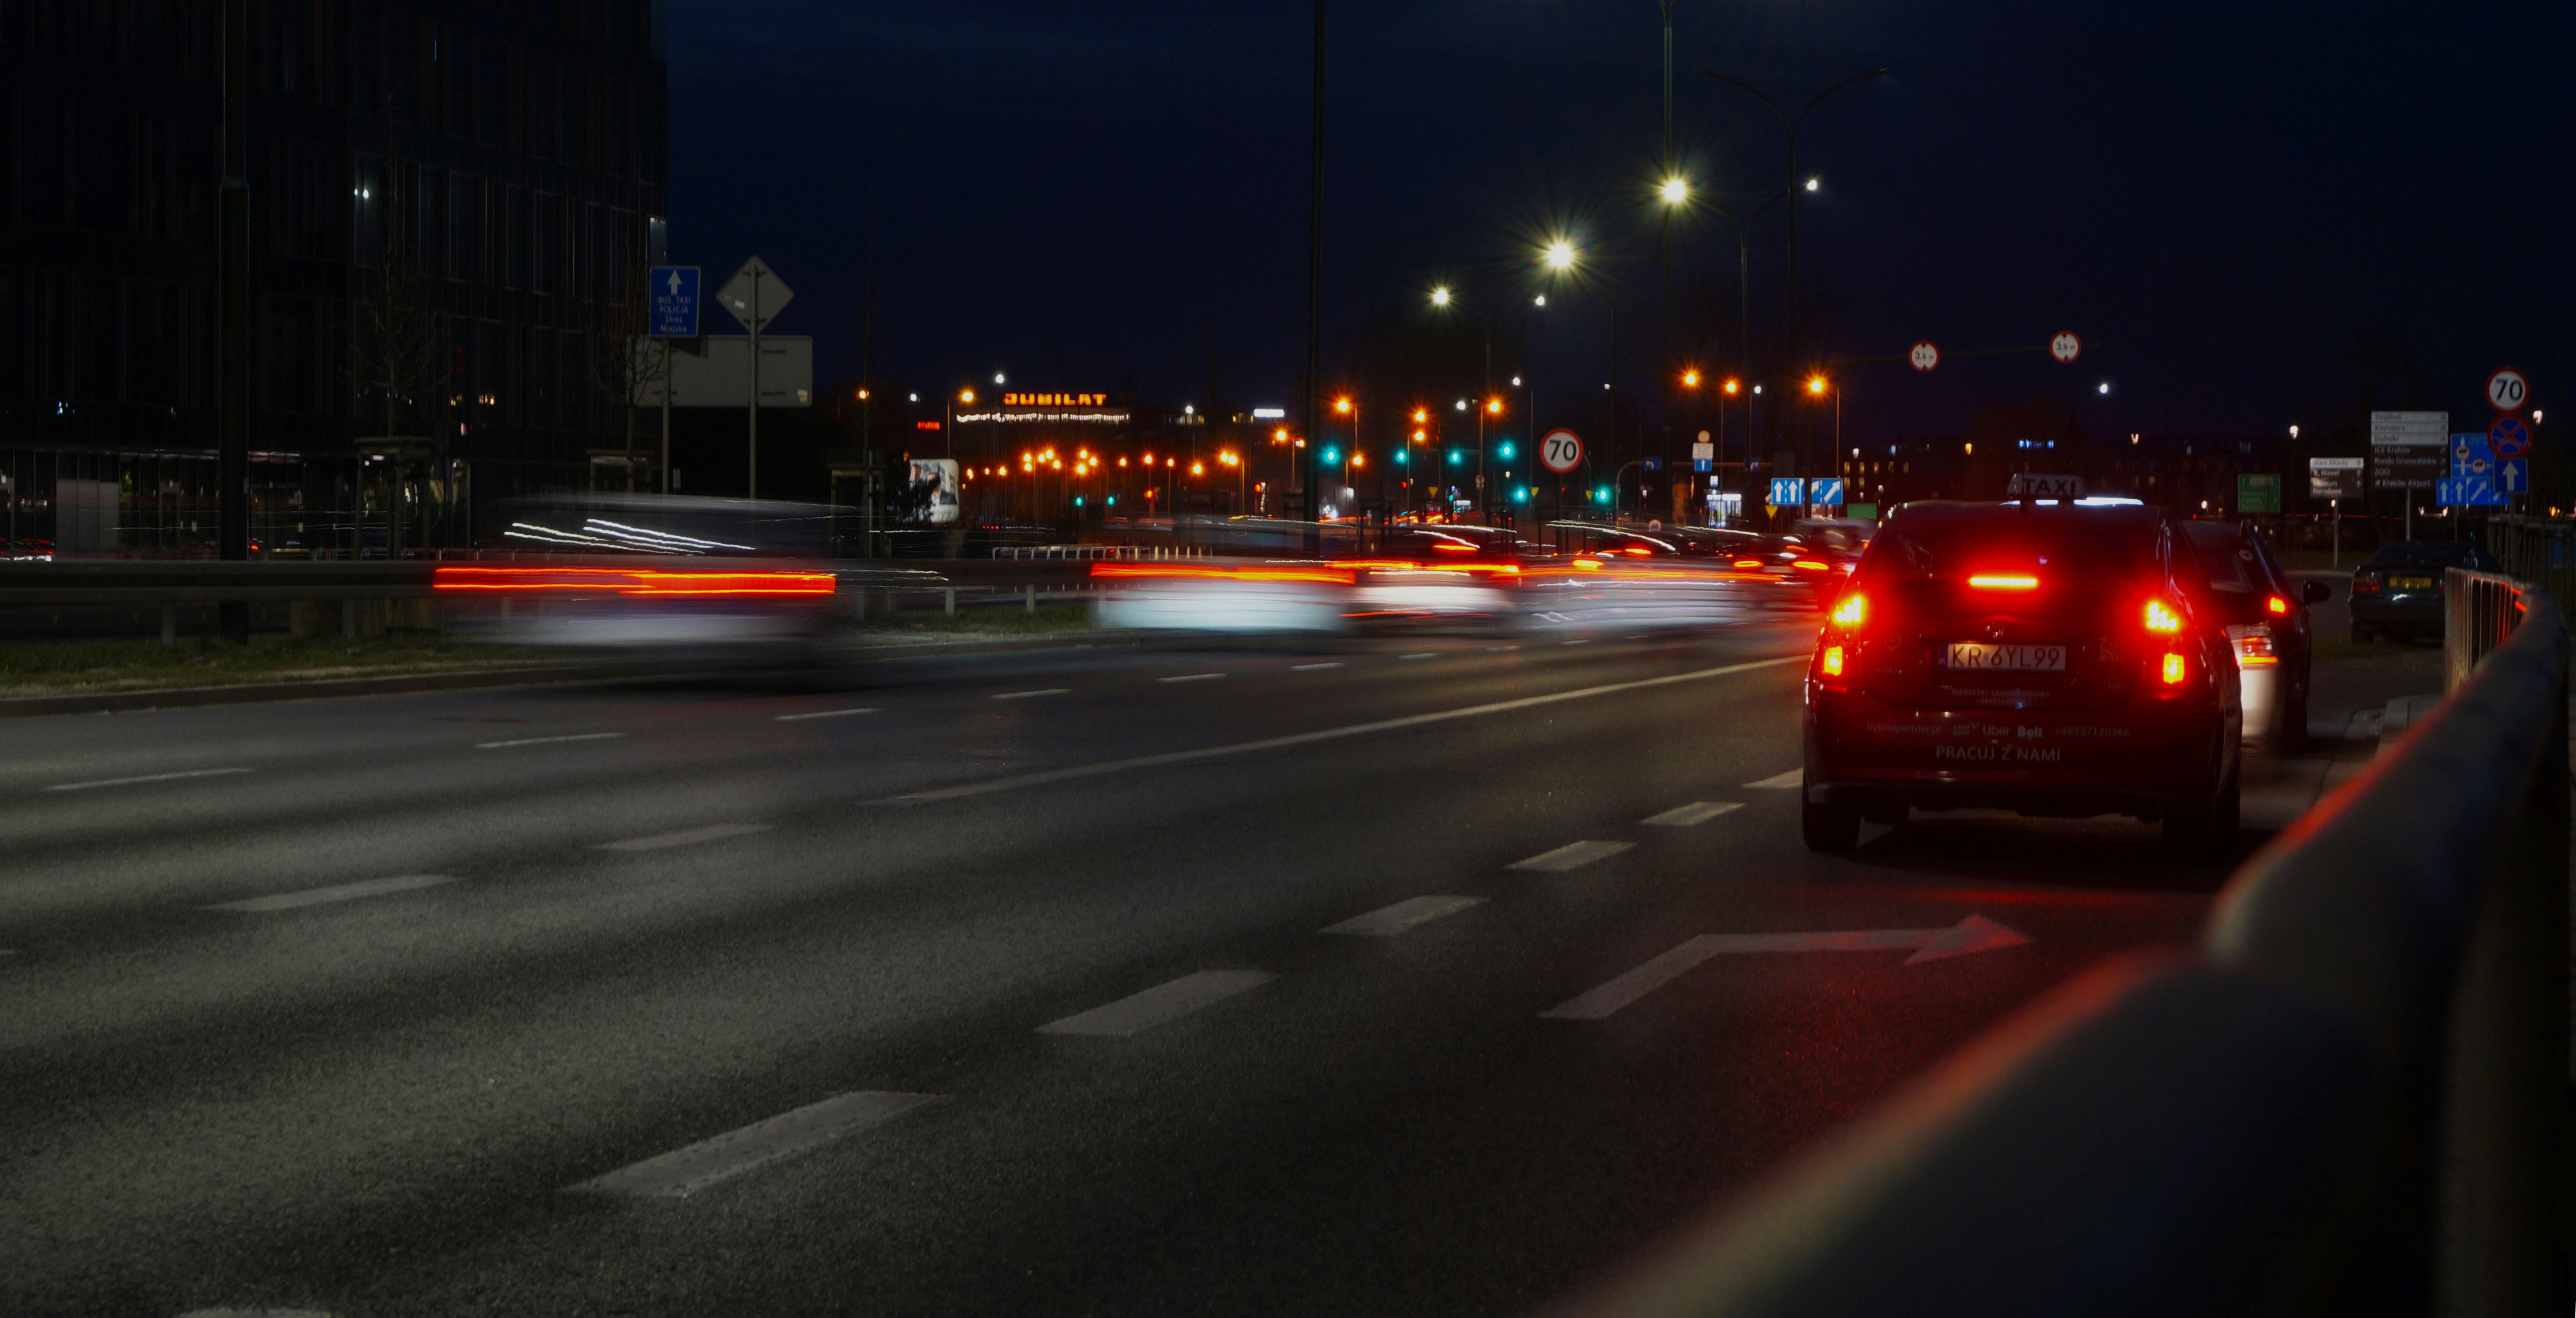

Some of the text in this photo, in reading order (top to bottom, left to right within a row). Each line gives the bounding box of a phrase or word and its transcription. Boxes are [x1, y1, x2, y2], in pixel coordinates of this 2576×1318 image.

[676, 296, 691, 304] TAXI
[659, 305, 689, 314] POLICJA
[2496, 378, 2523, 401] 70
[1005, 393, 1107, 406] JUBILAT
[1549, 439, 1577, 461] 70
[2374, 468, 2391, 476] ZOO
[2023, 478, 2076, 495] TAXI
[2382, 479, 2430, 488] Kraków Airport
[1953, 645, 2059, 667] KR 6YL99
[1982, 724, 2011, 736] Uber
[2017, 724, 2043, 740] Bolt
[1936, 745, 2060, 763] PRACUJ Z NAMI
